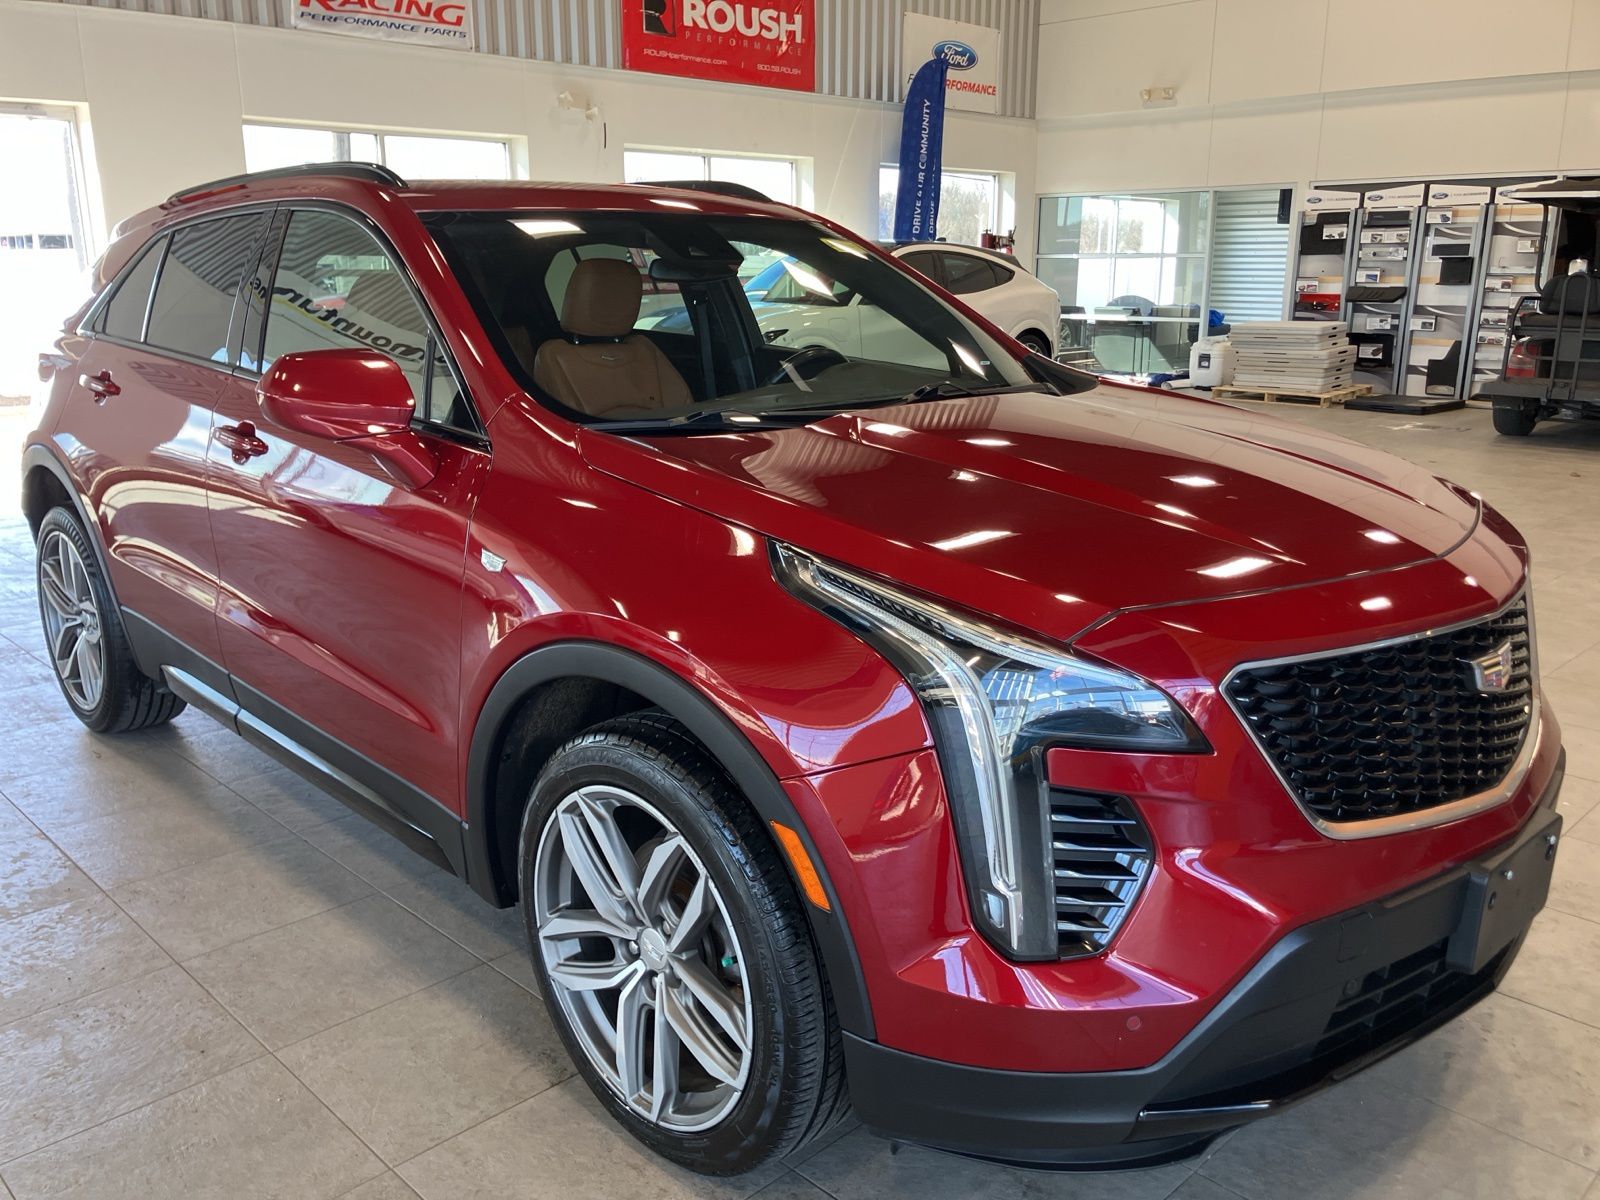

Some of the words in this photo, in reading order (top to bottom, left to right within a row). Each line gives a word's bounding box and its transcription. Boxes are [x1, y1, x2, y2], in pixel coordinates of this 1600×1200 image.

[300, 11, 419, 33] PERFORMANCE
[424, 27, 467, 39] PARTS
[683, 0, 803, 43] ROUSH
[941, 45, 970, 66] Ford
[944, 79, 997, 96] RFORMANCE
[912, 200, 922, 234] DRIVE
[919, 99, 931, 169] COMMUNITY
